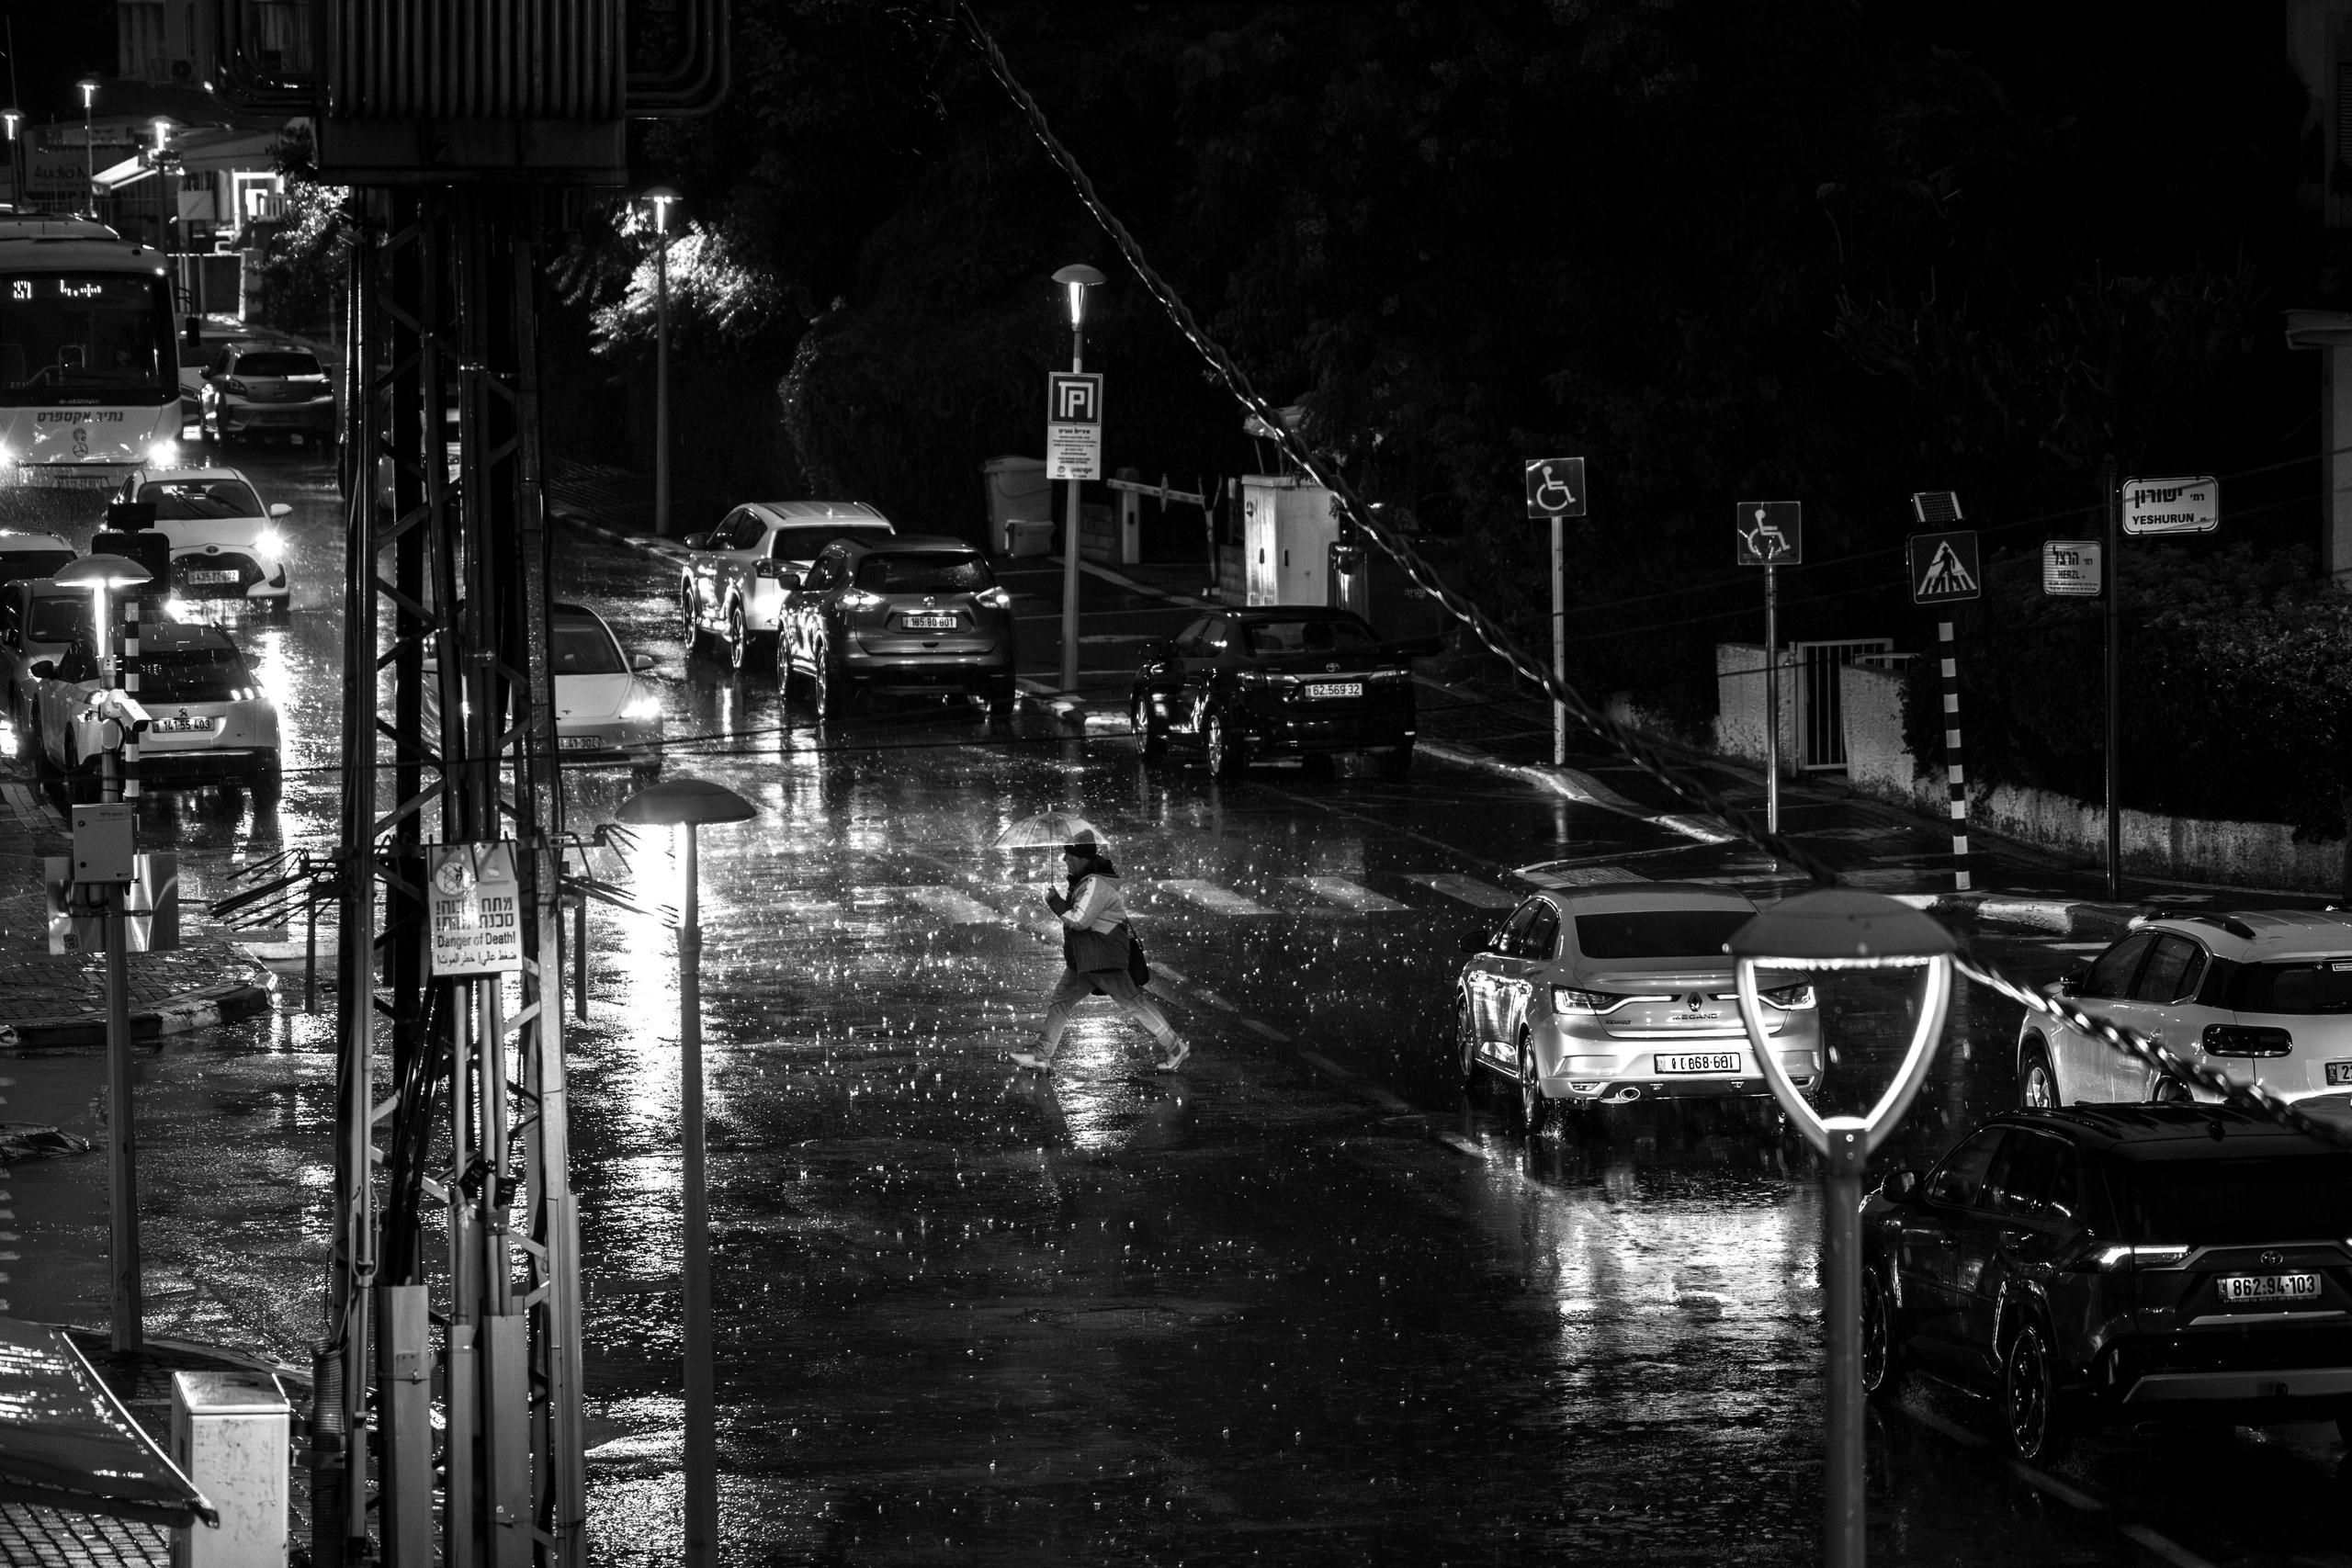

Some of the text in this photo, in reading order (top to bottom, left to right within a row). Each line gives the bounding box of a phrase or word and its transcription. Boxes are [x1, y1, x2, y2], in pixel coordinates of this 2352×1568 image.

[2134, 488, 2183, 509] ישורון
[2132, 513, 2195, 525] YESHURUN
[2052, 545, 2079, 566] הרצל
[2057, 570, 2080, 580] HERZL
[481, 897, 514, 913] מתח
[479, 913, 514, 929] סכנת
[437, 931, 516, 950] Danger of Death!
